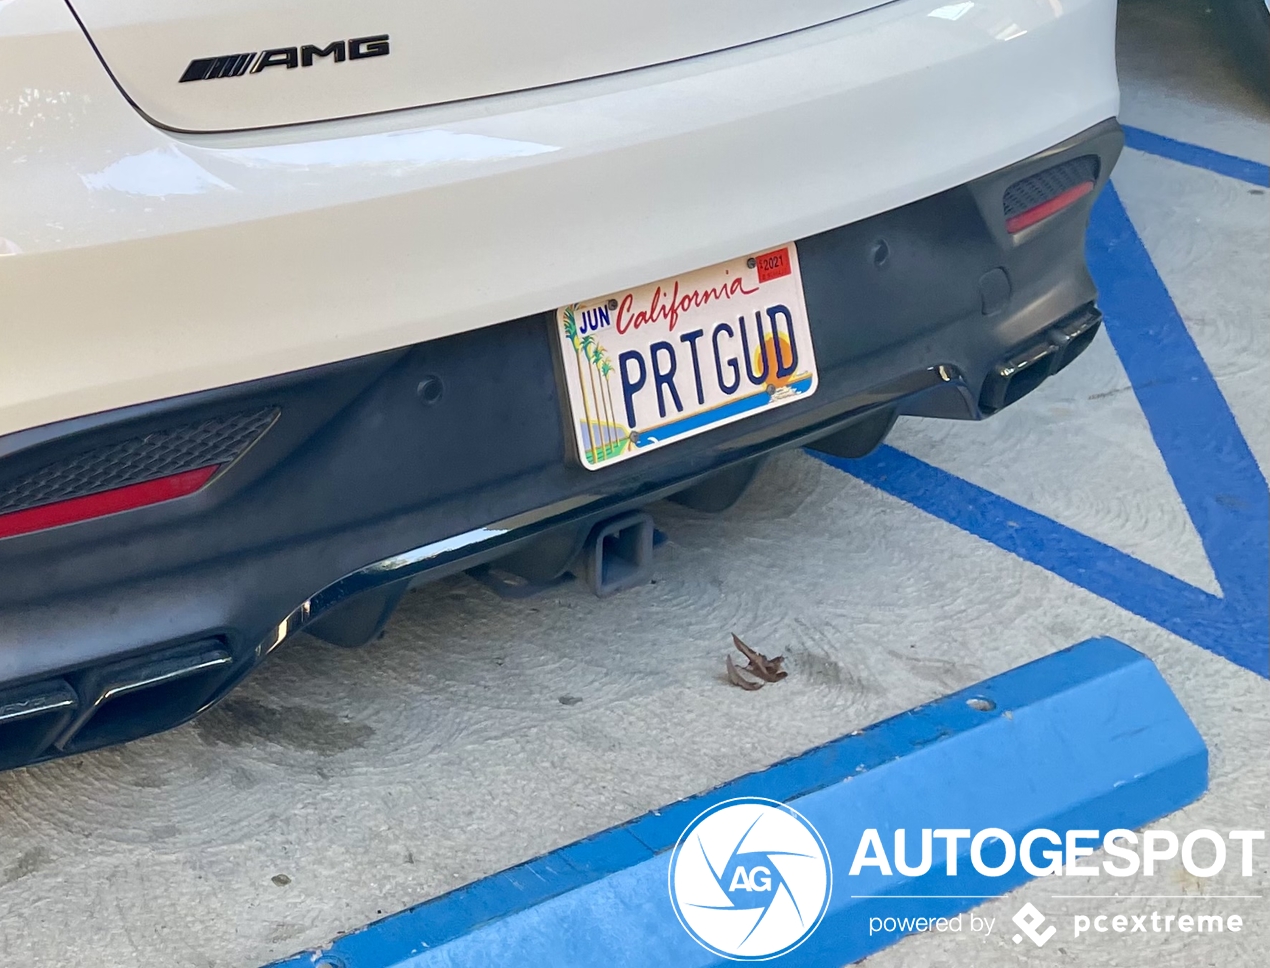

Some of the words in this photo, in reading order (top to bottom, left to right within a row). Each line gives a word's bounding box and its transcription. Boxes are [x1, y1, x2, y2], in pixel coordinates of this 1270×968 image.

[248, 33, 390, 75] AMG
[763, 255, 784, 271] 2021
[579, 304, 611, 334] JUN
[616, 269, 760, 335] California
[618, 304, 799, 429] PRTGUD
